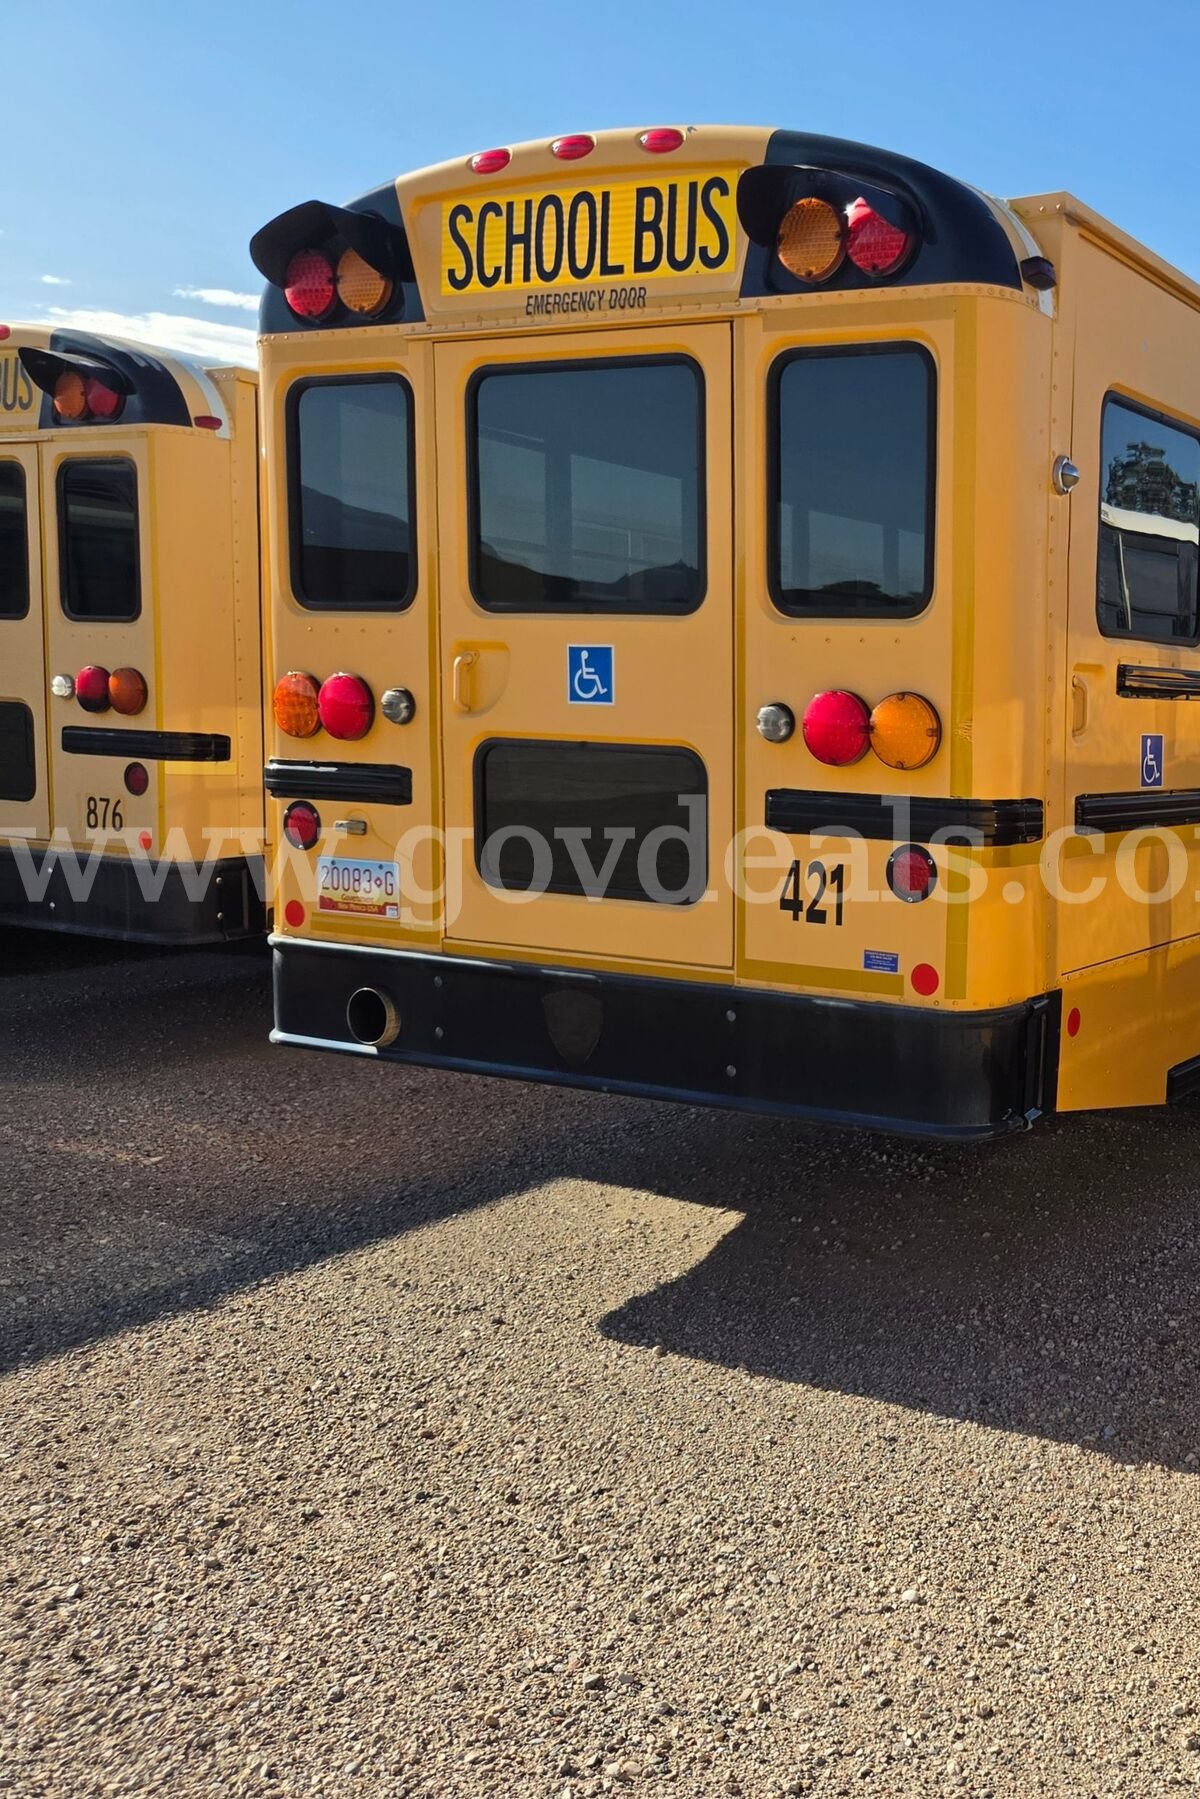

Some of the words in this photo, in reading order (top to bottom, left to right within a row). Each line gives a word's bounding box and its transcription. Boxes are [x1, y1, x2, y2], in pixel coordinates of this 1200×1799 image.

[447, 190, 625, 291] SCHOOL
[633, 176, 730, 274] BUS
[525, 289, 605, 316] EMERGENCY
[608, 286, 647, 310] DOOR
[0, 356, 33, 411] US
[86, 796, 123, 832] 876
[779, 859, 844, 926] 421
